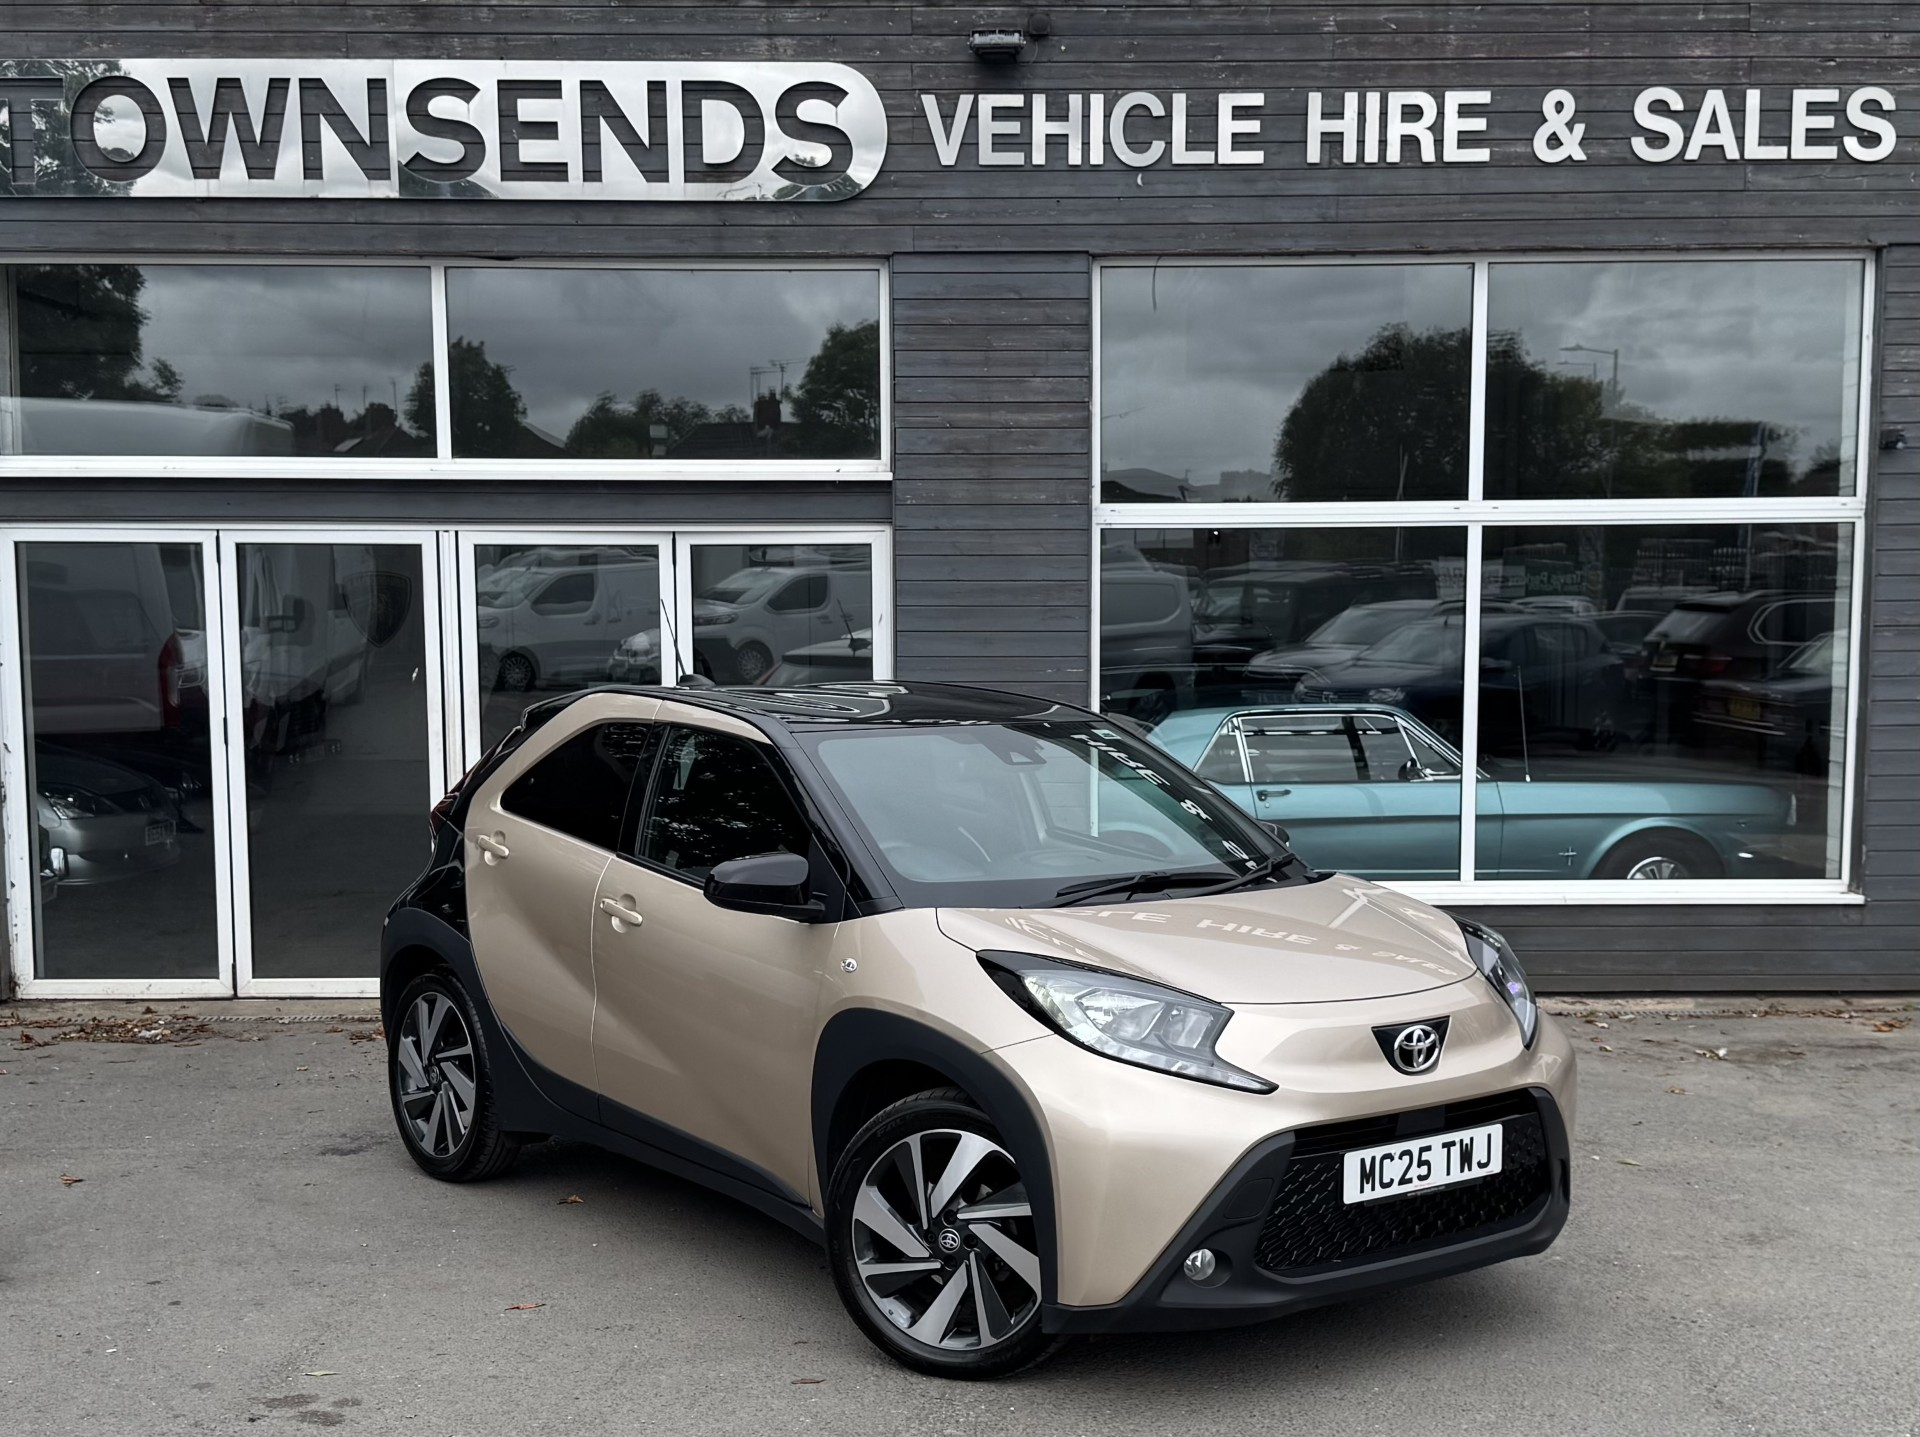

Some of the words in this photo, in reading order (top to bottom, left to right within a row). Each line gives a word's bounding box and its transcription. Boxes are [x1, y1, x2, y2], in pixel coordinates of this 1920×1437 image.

[0, 76, 854, 186] TOWNSENDS
[920, 92, 1265, 167] VEHICLE
[1307, 90, 1491, 164] HIRE
[1532, 88, 1588, 163] &
[1630, 86, 1898, 163] SALES
[1359, 1144, 1432, 1194] MC25
[1441, 1132, 1492, 1177] TWJ
